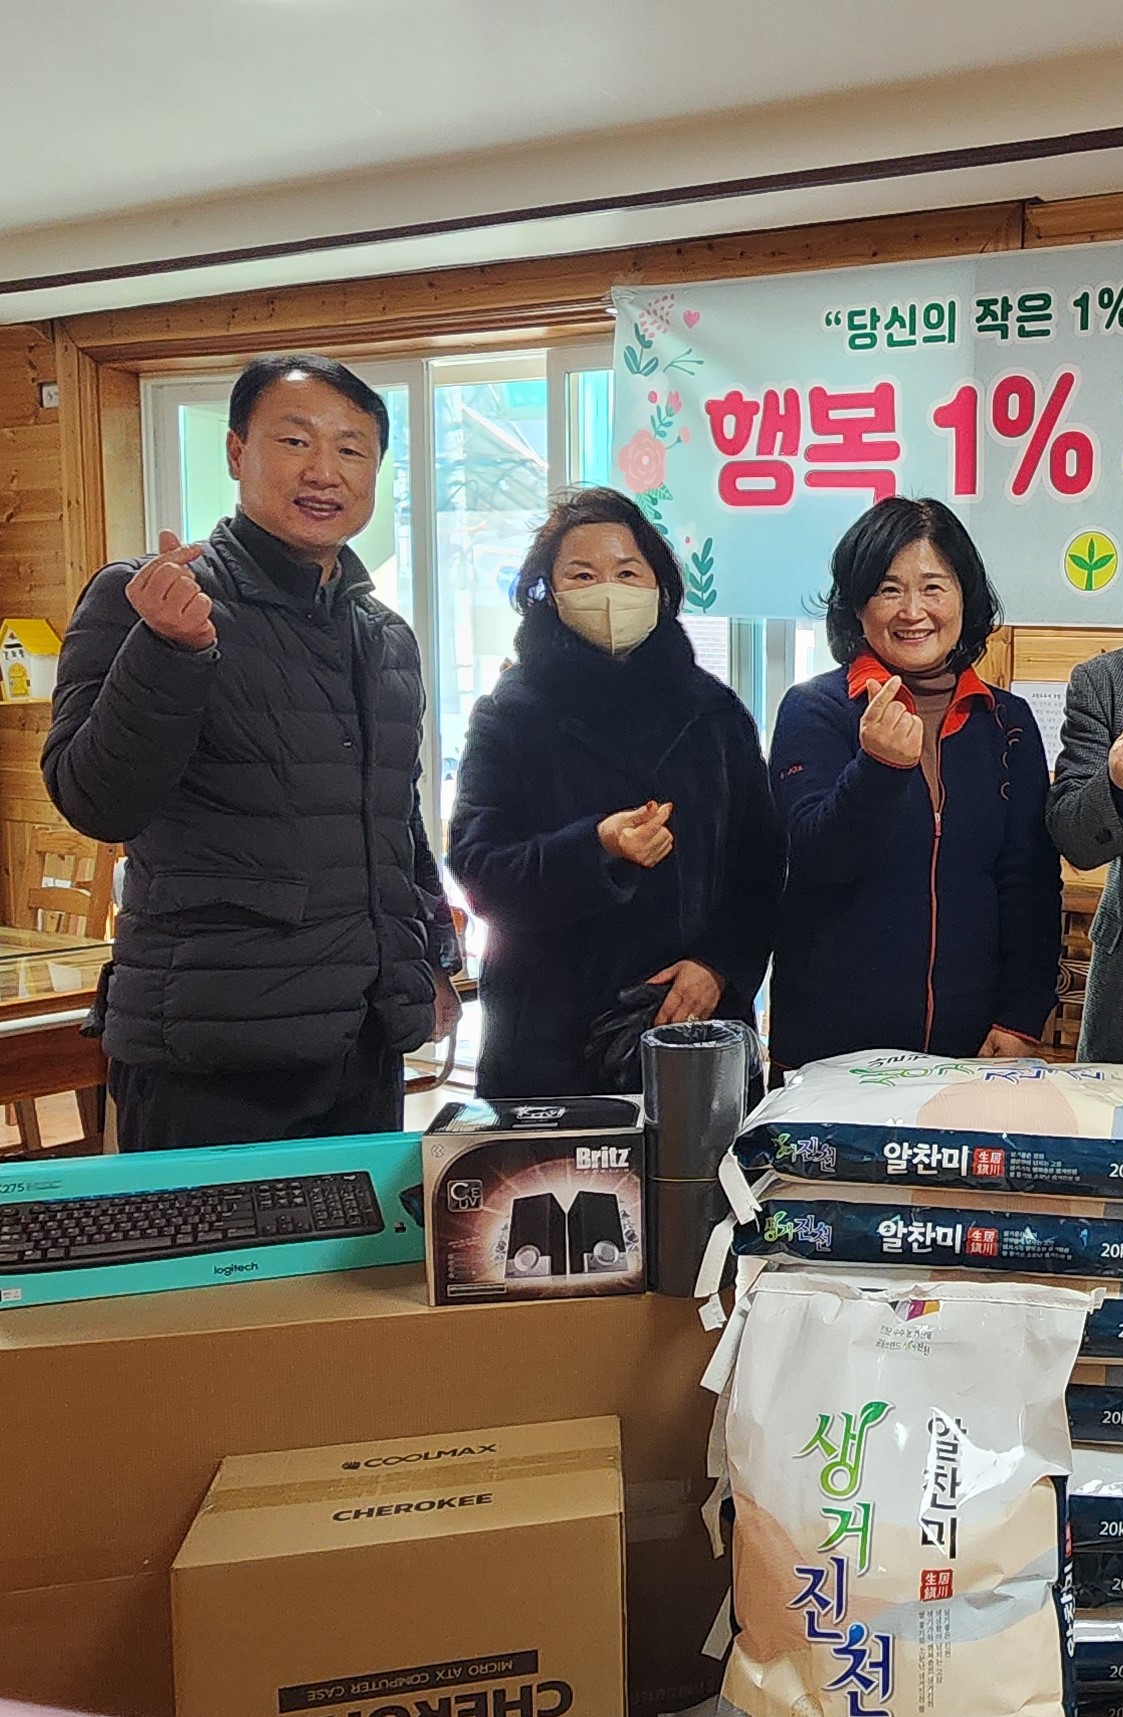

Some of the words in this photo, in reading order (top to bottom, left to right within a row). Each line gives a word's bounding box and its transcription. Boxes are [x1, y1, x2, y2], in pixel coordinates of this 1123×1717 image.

[825, 301, 957, 350] “당신의
[976, 293, 1053, 338] 작은
[705, 382, 901, 505] 행복
[933, 372, 1093, 496] 1%
[576, 1147, 631, 1169] Britz
[884, 1142, 969, 1177] 알찬미
[879, 1220, 962, 1254] 알찬미
[214, 1262, 259, 1276] logitech
[364, 1444, 497, 1468] COOLMAX
[921, 1416, 967, 1559] 알찬미
[332, 1493, 493, 1522] CHEROKEE
[436, 1666, 462, 1681] ATX
[469, 1659, 513, 1675] MICRO
[306, 1686, 344, 1701] CASE
[350, 1673, 430, 1694] COMPUTER
[345, 1681, 573, 1717] CHER
